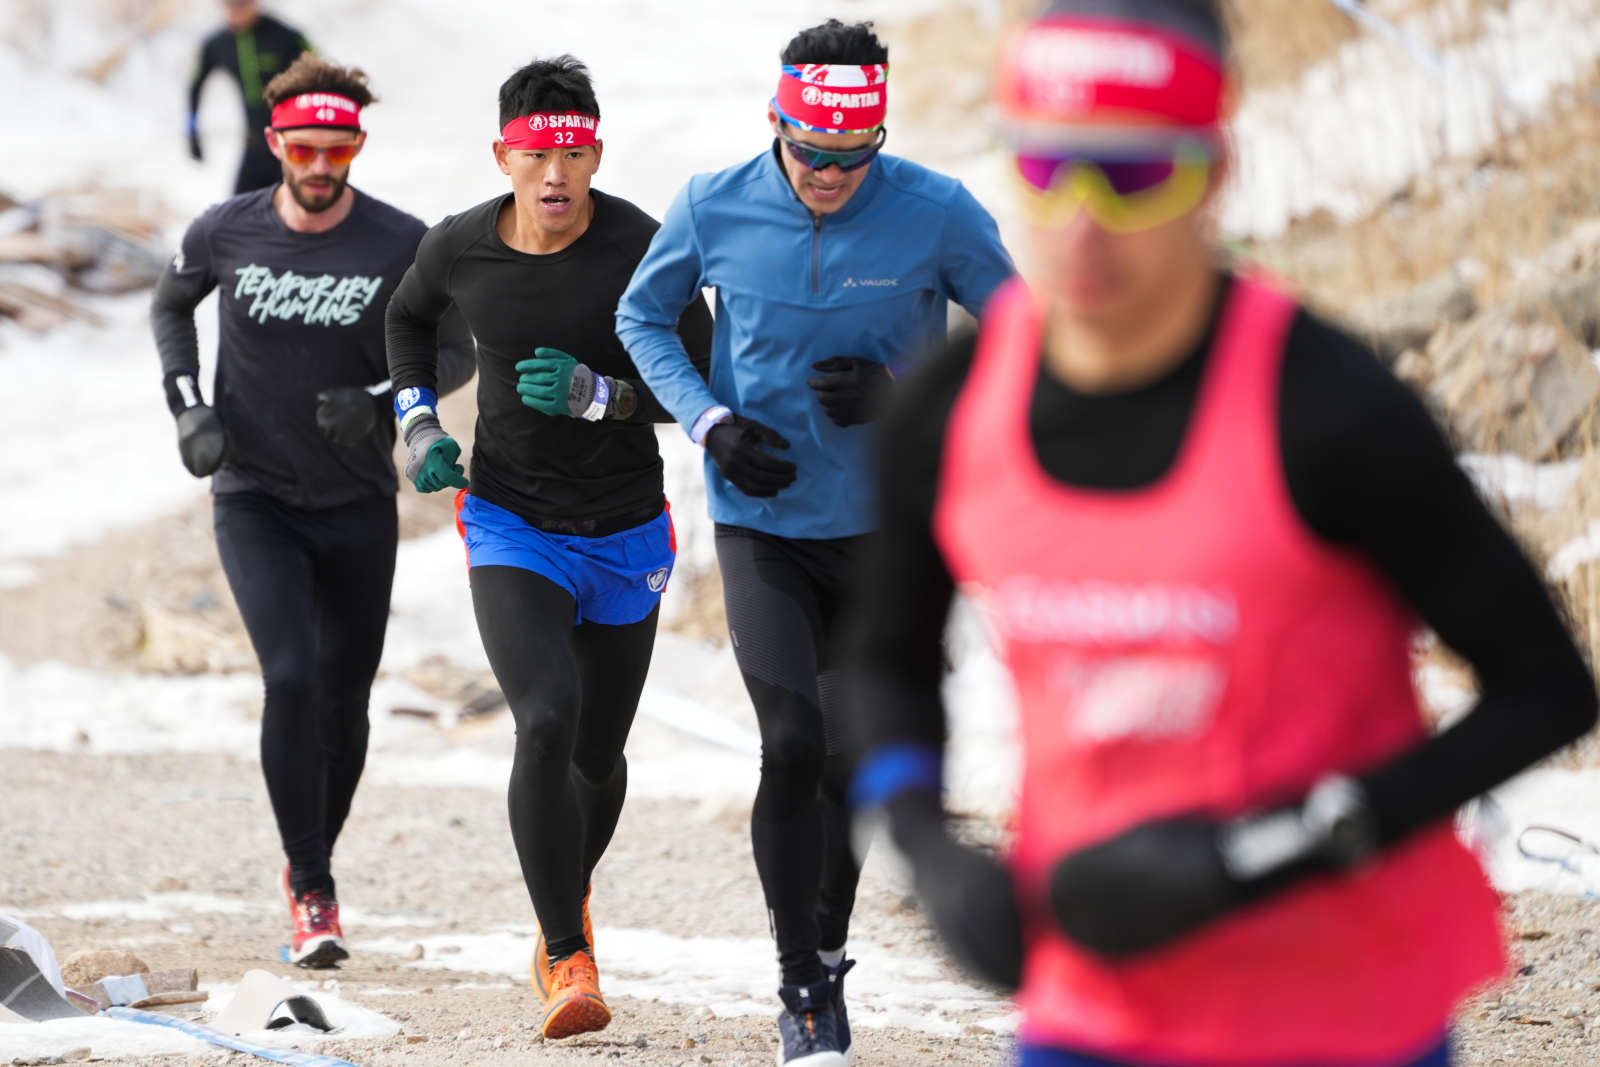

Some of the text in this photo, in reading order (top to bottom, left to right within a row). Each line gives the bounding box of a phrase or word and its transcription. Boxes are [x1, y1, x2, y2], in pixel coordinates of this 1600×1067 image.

[821, 91, 880, 108] SPARTAN
[549, 114, 595, 130] SPARTAN
[832, 111, 844, 125] 9
[554, 131, 575, 144] 32
[234, 263, 383, 306] TEMPORARY
[248, 294, 364, 328] HUMANS
